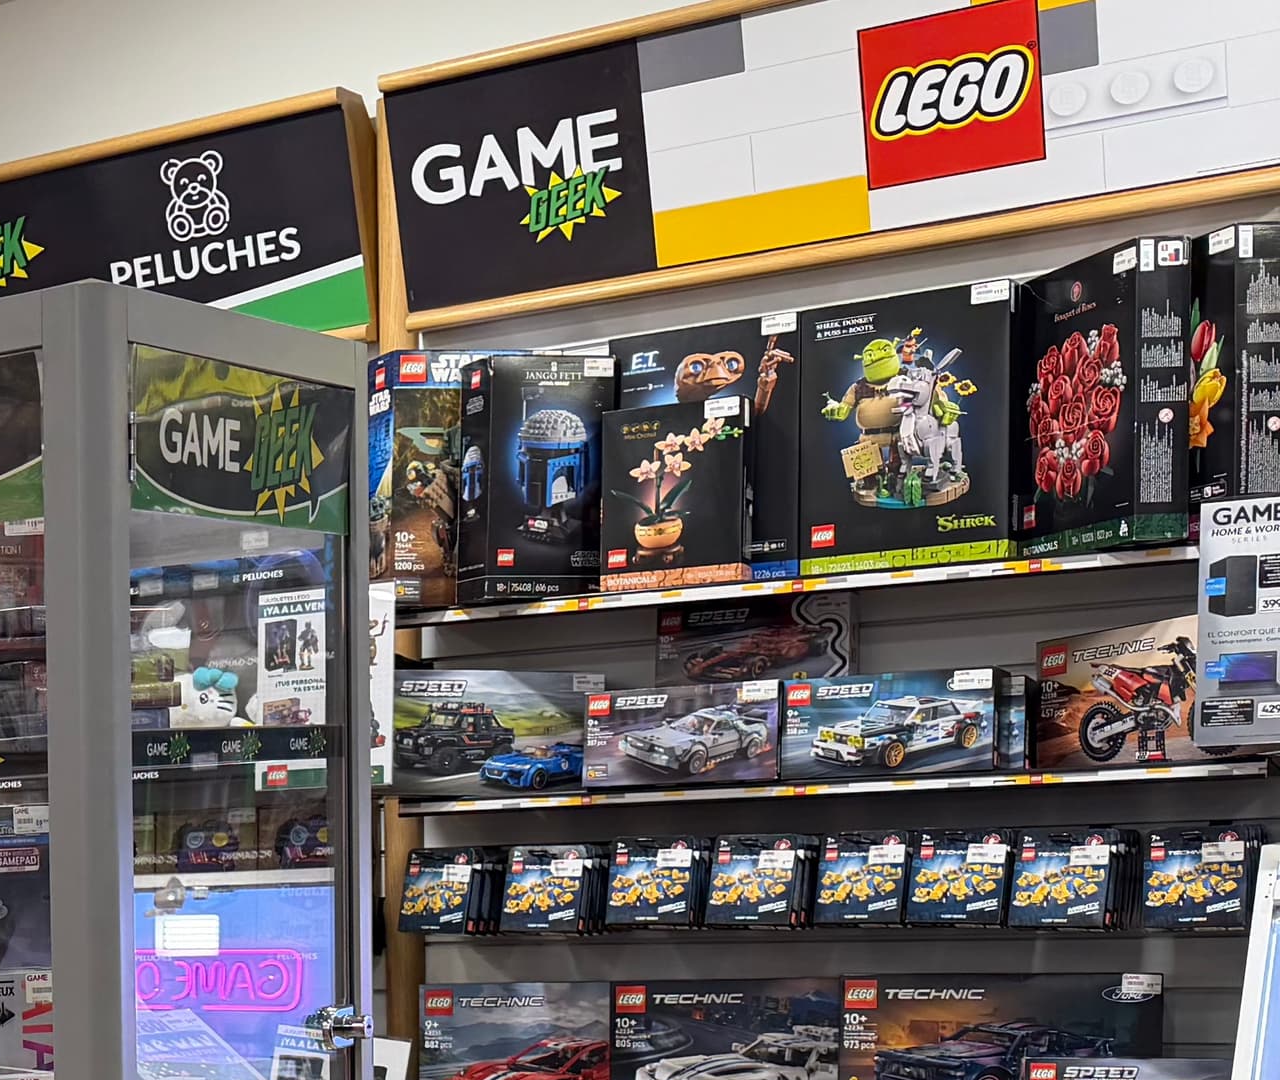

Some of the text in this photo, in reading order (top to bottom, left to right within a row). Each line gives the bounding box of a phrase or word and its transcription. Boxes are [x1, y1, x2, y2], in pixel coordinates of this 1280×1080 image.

[876, 54, 1027, 134] LEGO
[411, 109, 622, 204] GAME
[529, 166, 607, 233] GEEK
[110, 228, 300, 289] PELUCHES
[631, 351, 659, 370] E.T.
[401, 360, 426, 375] LEGO
[525, 371, 583, 381] JANGO FETT
[160, 403, 316, 490] GAME GEEK
[243, 570, 283, 583] PELUCHES
[1073, 638, 1155, 663] TECHNIC
[400, 680, 467, 692] SPEED
[616, 695, 667, 707] SPEED
[617, 992, 643, 1005] LEGO
[847, 987, 875, 1000] LEGO
[885, 989, 984, 1000] TECHNIC
[427, 996, 450, 1008] LEGO
[460, 997, 544, 1007] TECHNIC
[844, 1014, 867, 1024] 10+
